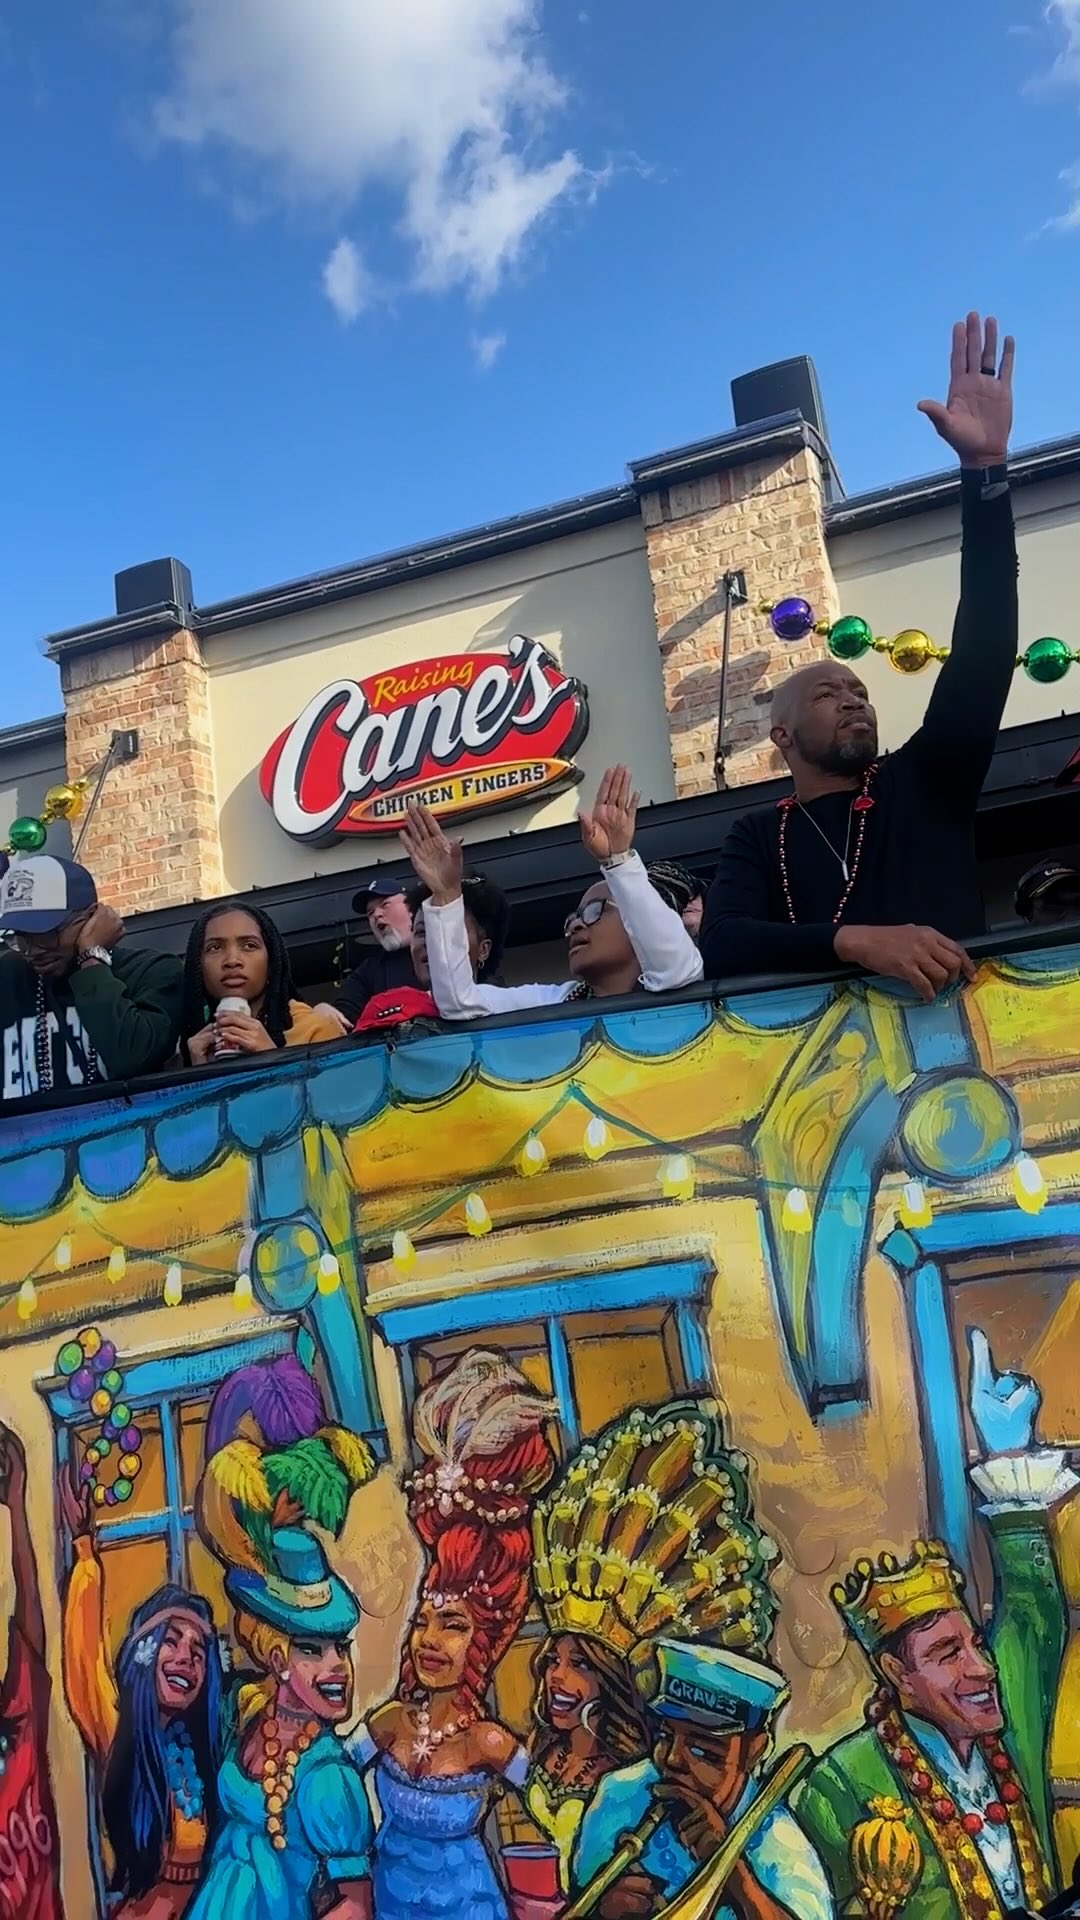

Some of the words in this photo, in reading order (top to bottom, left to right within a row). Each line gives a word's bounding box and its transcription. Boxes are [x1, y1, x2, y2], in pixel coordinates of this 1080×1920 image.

[373, 661, 474, 707] Raising
[273, 635, 580, 834] Cane's
[461, 765, 545, 796] FINGERS
[669, 1679, 737, 1715] GRAVES
[0, 1785, 52, 1900] 996
